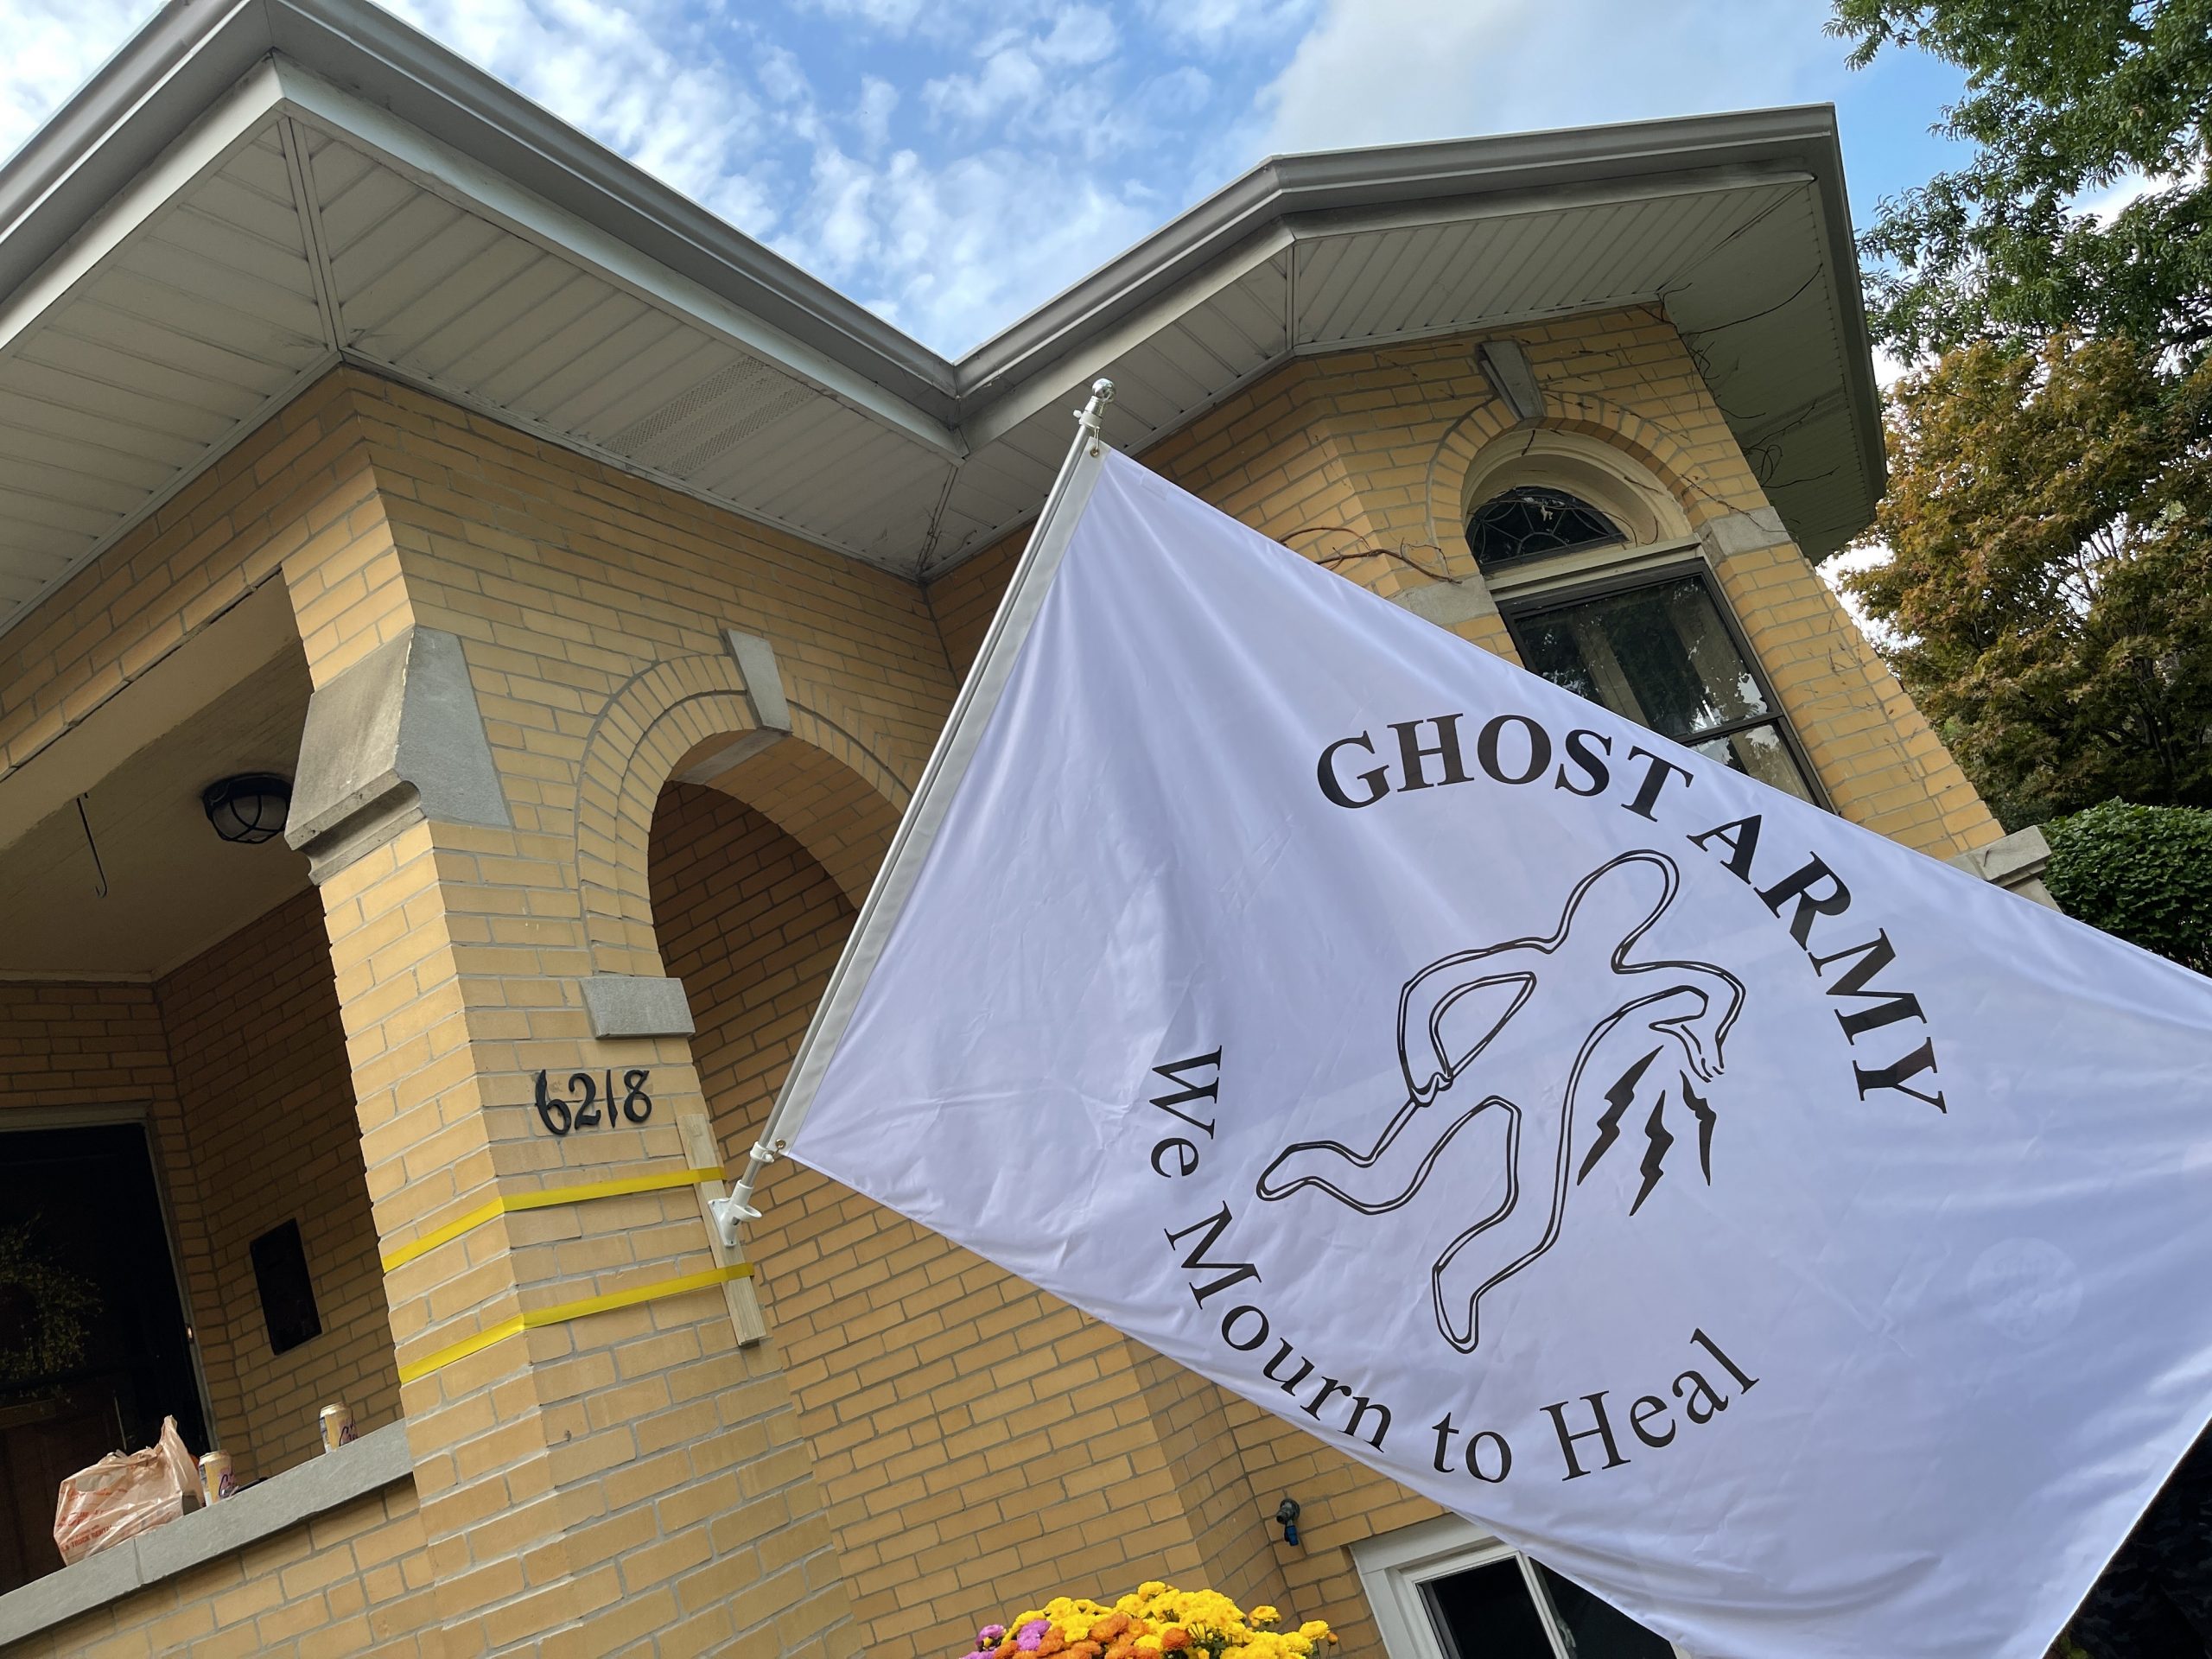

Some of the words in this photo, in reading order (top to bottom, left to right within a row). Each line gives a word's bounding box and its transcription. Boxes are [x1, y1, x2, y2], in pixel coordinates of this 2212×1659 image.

[1318, 713, 1694, 823] GHOST
[1687, 814, 1948, 1115] ARMY
[535, 1069, 652, 1135] 6218
[1148, 1045, 1223, 1179] We
[1163, 1199, 1392, 1453] Mourn
[1432, 1412, 1512, 1484] to
[1539, 1327, 1760, 1482] Heal
